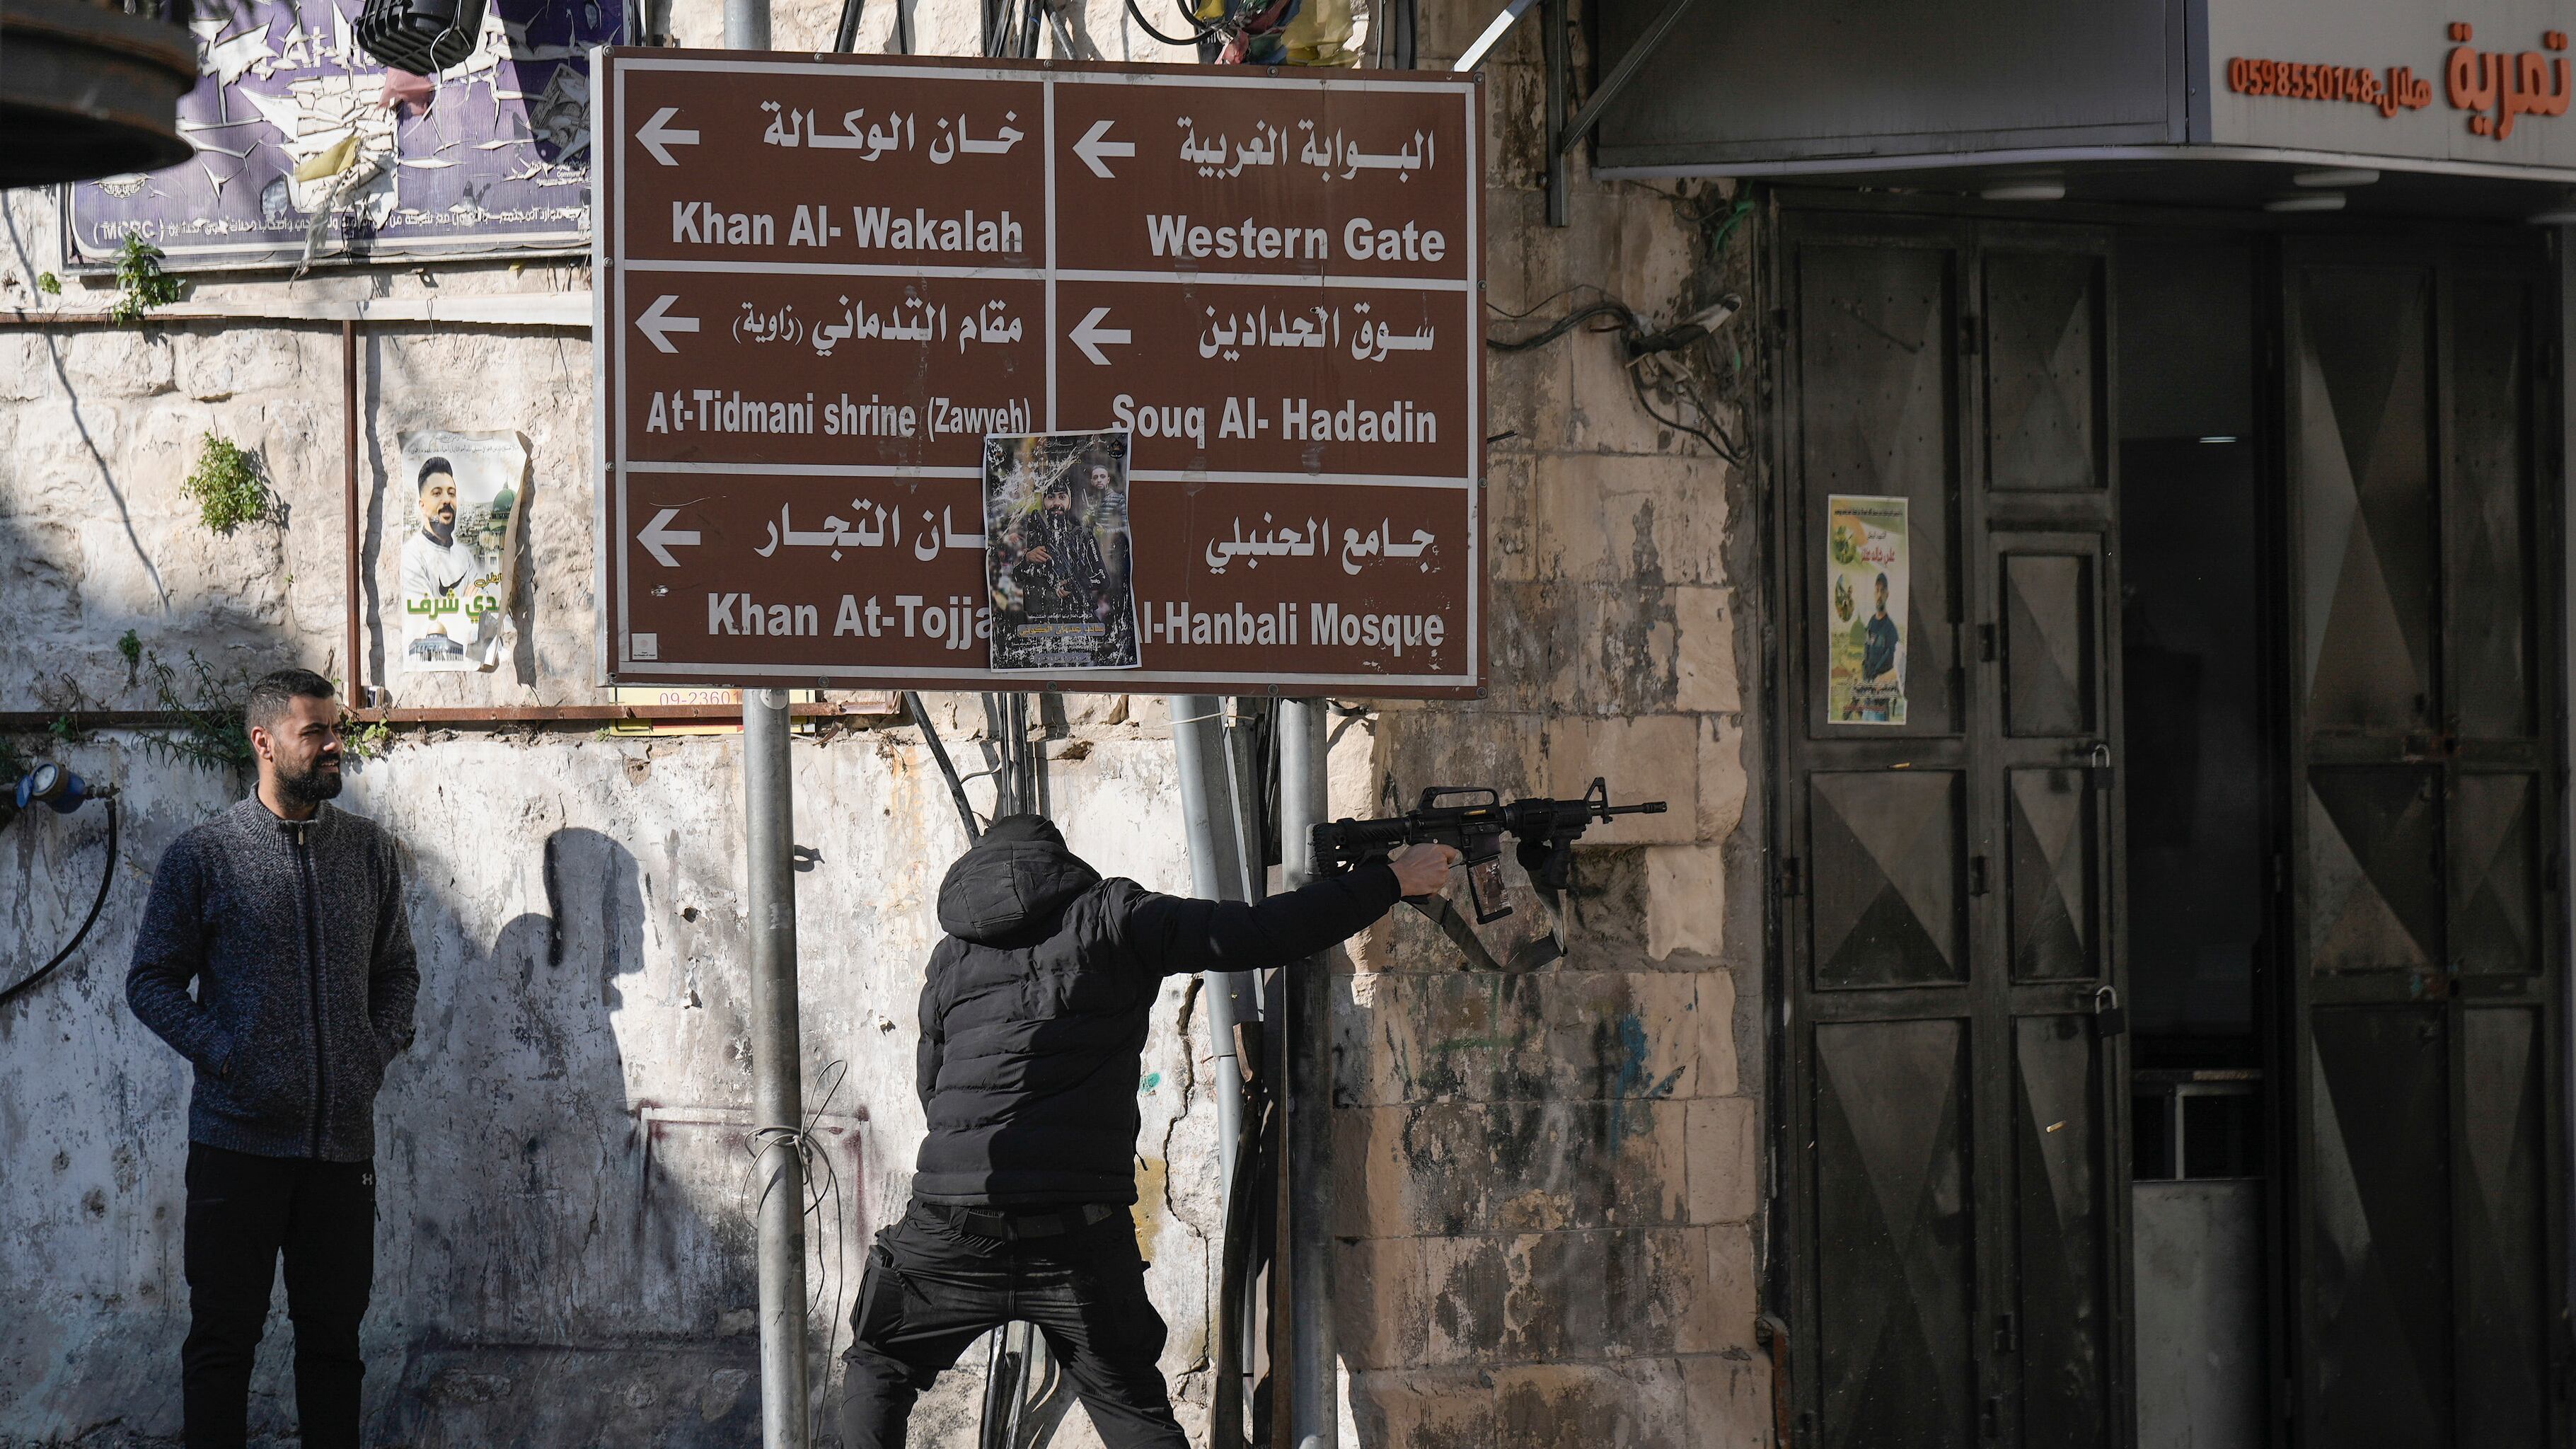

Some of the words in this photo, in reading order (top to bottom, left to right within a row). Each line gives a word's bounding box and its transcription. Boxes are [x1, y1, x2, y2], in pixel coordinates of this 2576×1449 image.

[760, 100, 915, 162] الوكالة
[929, 110, 1024, 165] خان
[1177, 116, 1288, 180] الغربية
[1298, 119, 1434, 183] البوابة
[672, 201, 775, 246] Khan
[787, 204, 841, 247] Al-
[853, 206, 1022, 253] Wakalah
[1146, 214, 1328, 260] Western
[1344, 217, 1445, 262] Gate
[732, 301, 803, 346] (زاوية)
[812, 294, 947, 357] التدماني
[959, 299, 1023, 355] مقام
[1199, 304, 1340, 362] الحدادين
[1351, 301, 1434, 362] سوق
[646, 389, 814, 434] At-Tidmani
[824, 393, 917, 437] shrine
[927, 396, 1032, 443] (Zawyeh)
[1111, 393, 1205, 449] Souq
[1218, 396, 1269, 439] Al-
[1283, 398, 1436, 443] Hadadin
[753, 497, 900, 562] التجار
[914, 504, 987, 562] ان
[1206, 512, 1329, 575] الحنبلي
[1341, 517, 1435, 575] جامع
[408, 588, 459, 620] شرف
[707, 592, 818, 636] Khan
[833, 593, 992, 651] At-Tojja
[1138, 601, 1298, 645] l-Hanbali
[1310, 603, 1445, 657] Mosque
